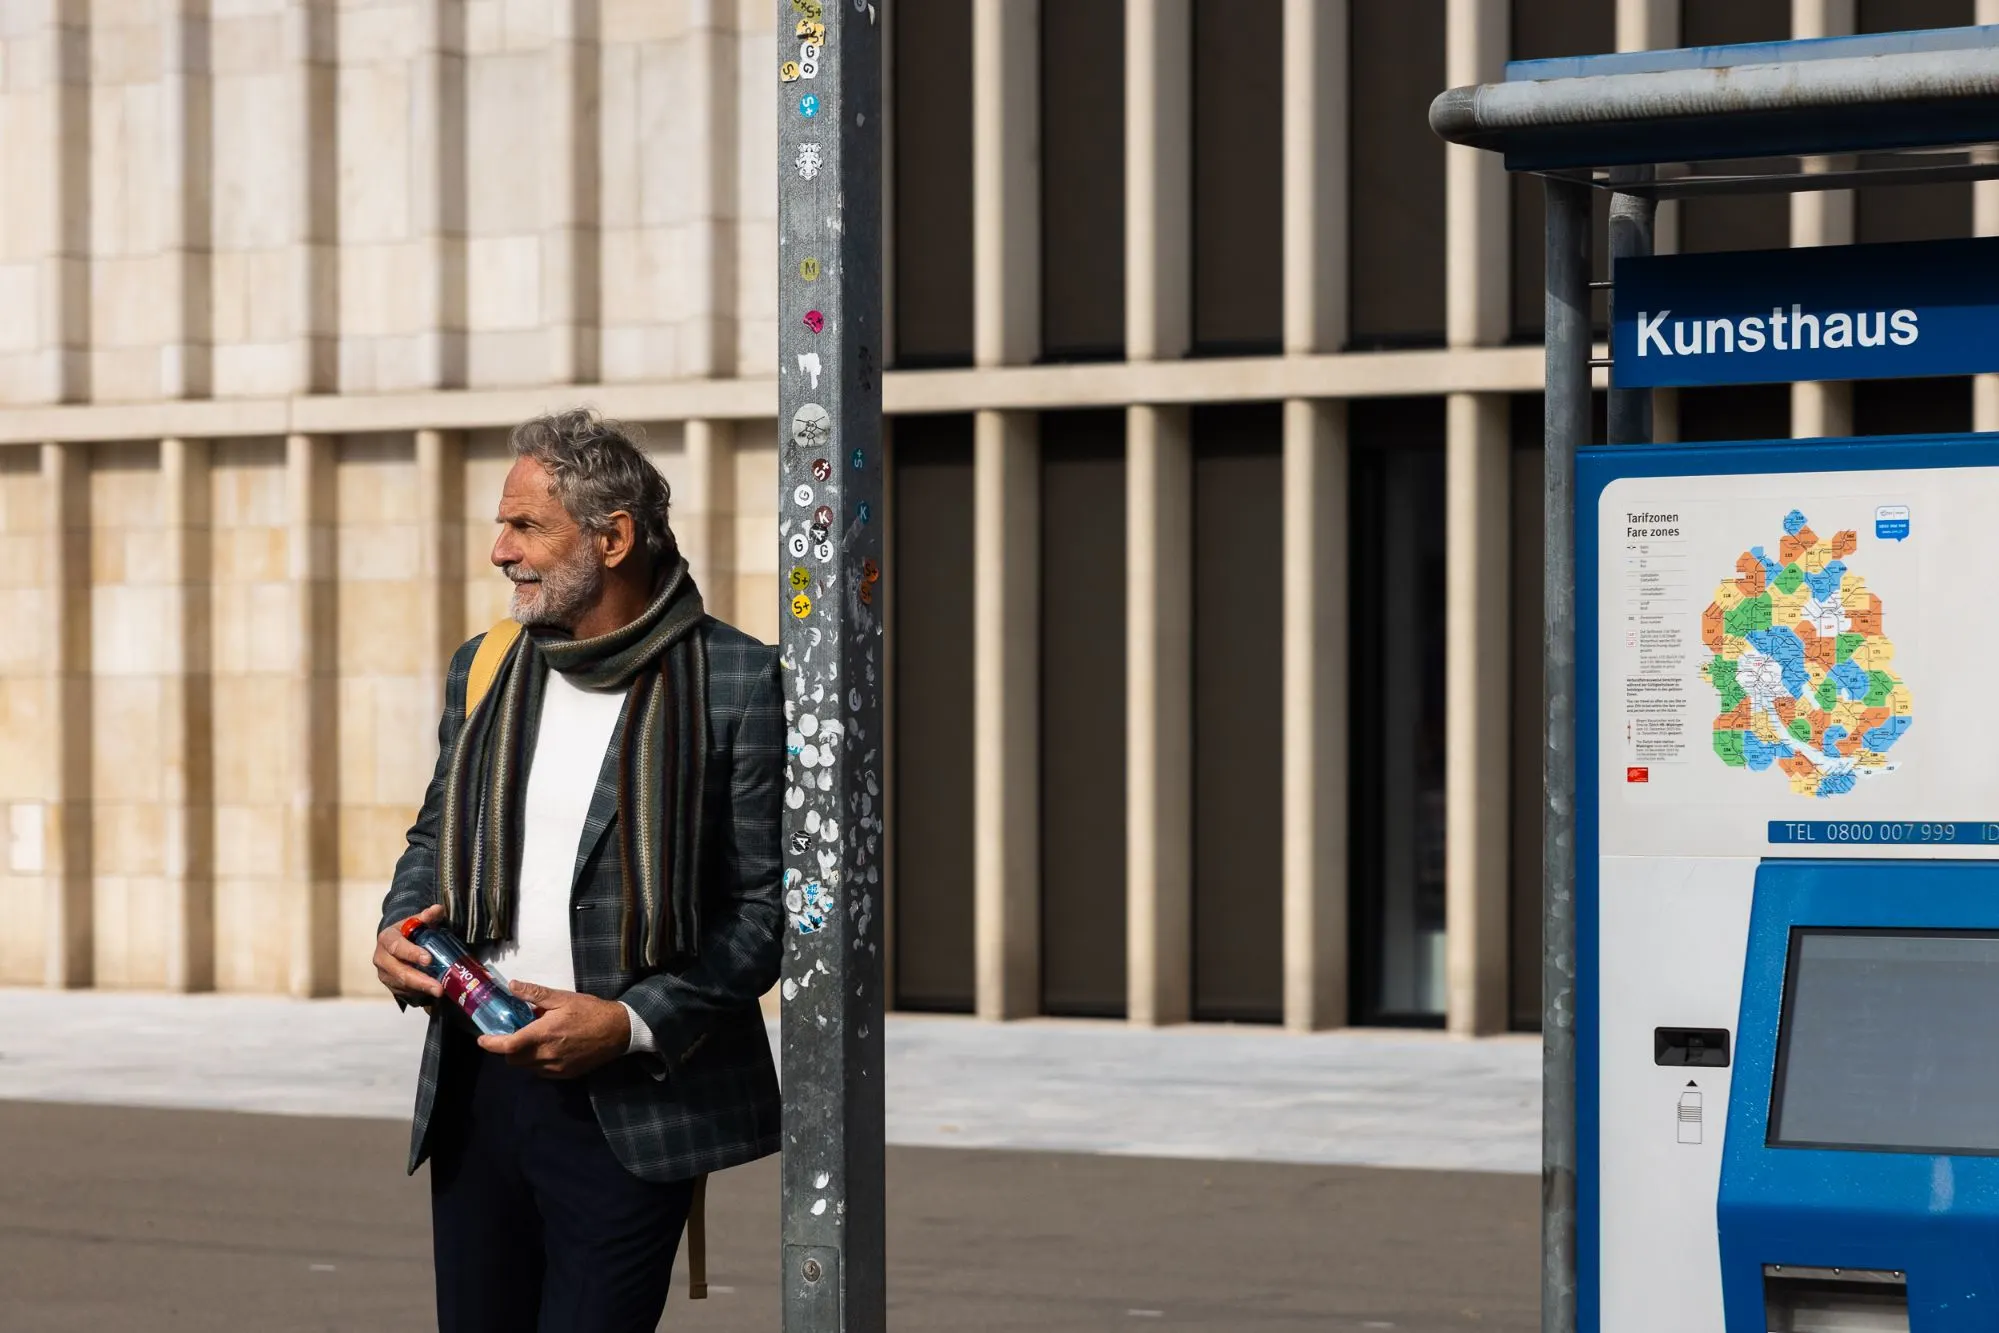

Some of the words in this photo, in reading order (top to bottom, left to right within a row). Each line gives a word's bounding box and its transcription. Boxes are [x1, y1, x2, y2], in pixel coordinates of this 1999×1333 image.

[806, 6, 822, 18] S+
[806, 45, 815, 58] G
[803, 63, 814, 74] G
[802, 96, 815, 116] S+
[806, 262, 816, 275] M
[1637, 304, 1919, 357] Kunsthaus
[814, 462, 829, 480] S+
[818, 510, 829, 524] K
[1626, 512, 1678, 523] Tarifzonen
[1627, 528, 1648, 537] Fare
[1650, 528, 1680, 536] zones
[794, 539, 804, 552] G
[820, 544, 828, 558] G
[793, 572, 808, 585] S+
[794, 601, 810, 614] S+
[1786, 824, 1815, 840] TEL
[1827, 824, 1873, 840] 0800
[1880, 824, 1914, 840] 007
[1920, 824, 1956, 841] 999
